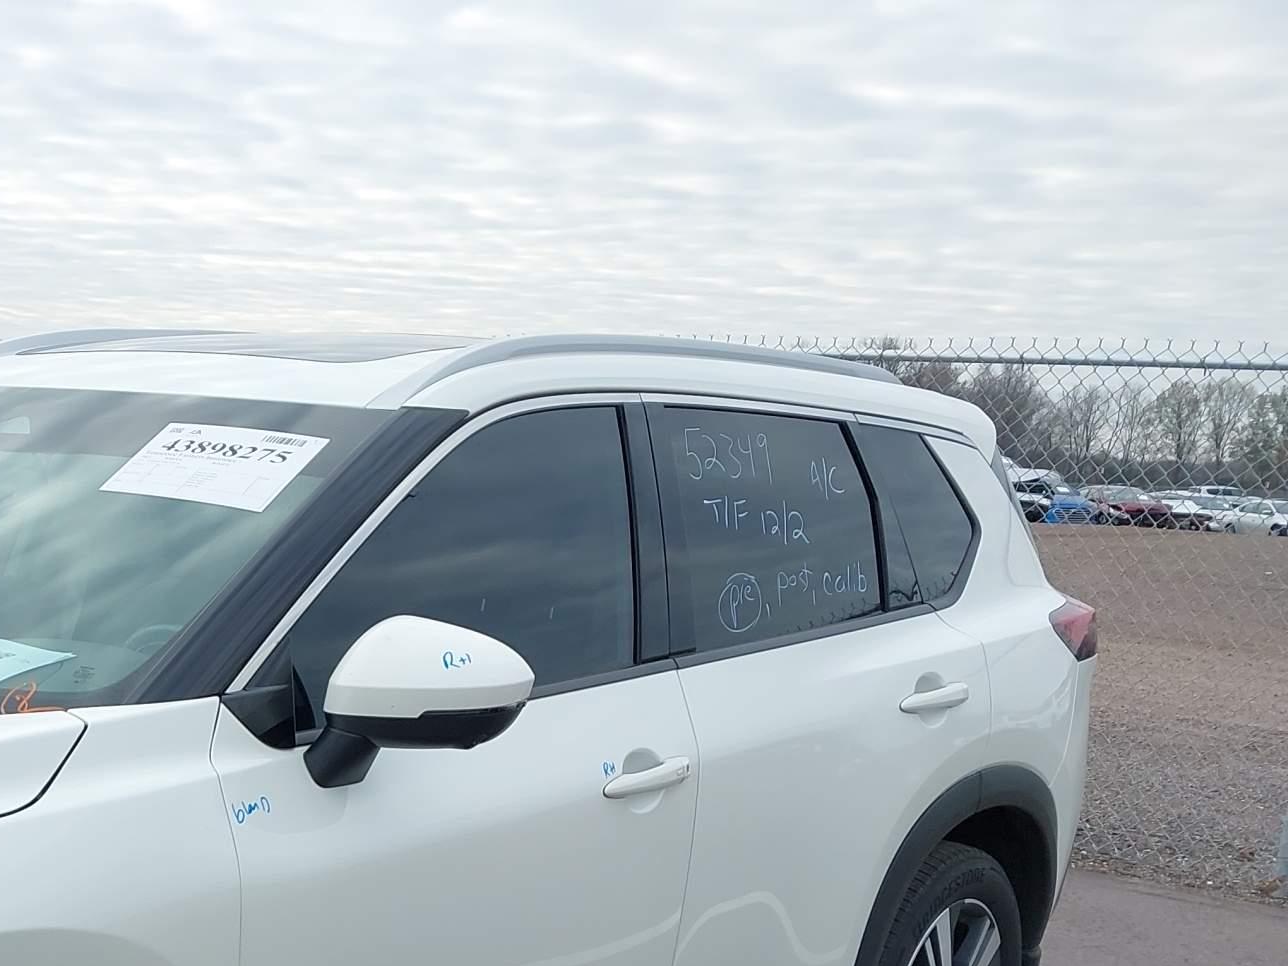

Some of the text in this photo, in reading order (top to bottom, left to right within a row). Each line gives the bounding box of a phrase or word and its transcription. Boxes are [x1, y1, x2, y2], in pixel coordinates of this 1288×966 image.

[162, 438, 294, 464] 43898275
[684, 427, 774, 486] 52349
[808, 457, 846, 501] A/C
[760, 500, 811, 545] 12/2
[822, 560, 868, 595] calib
